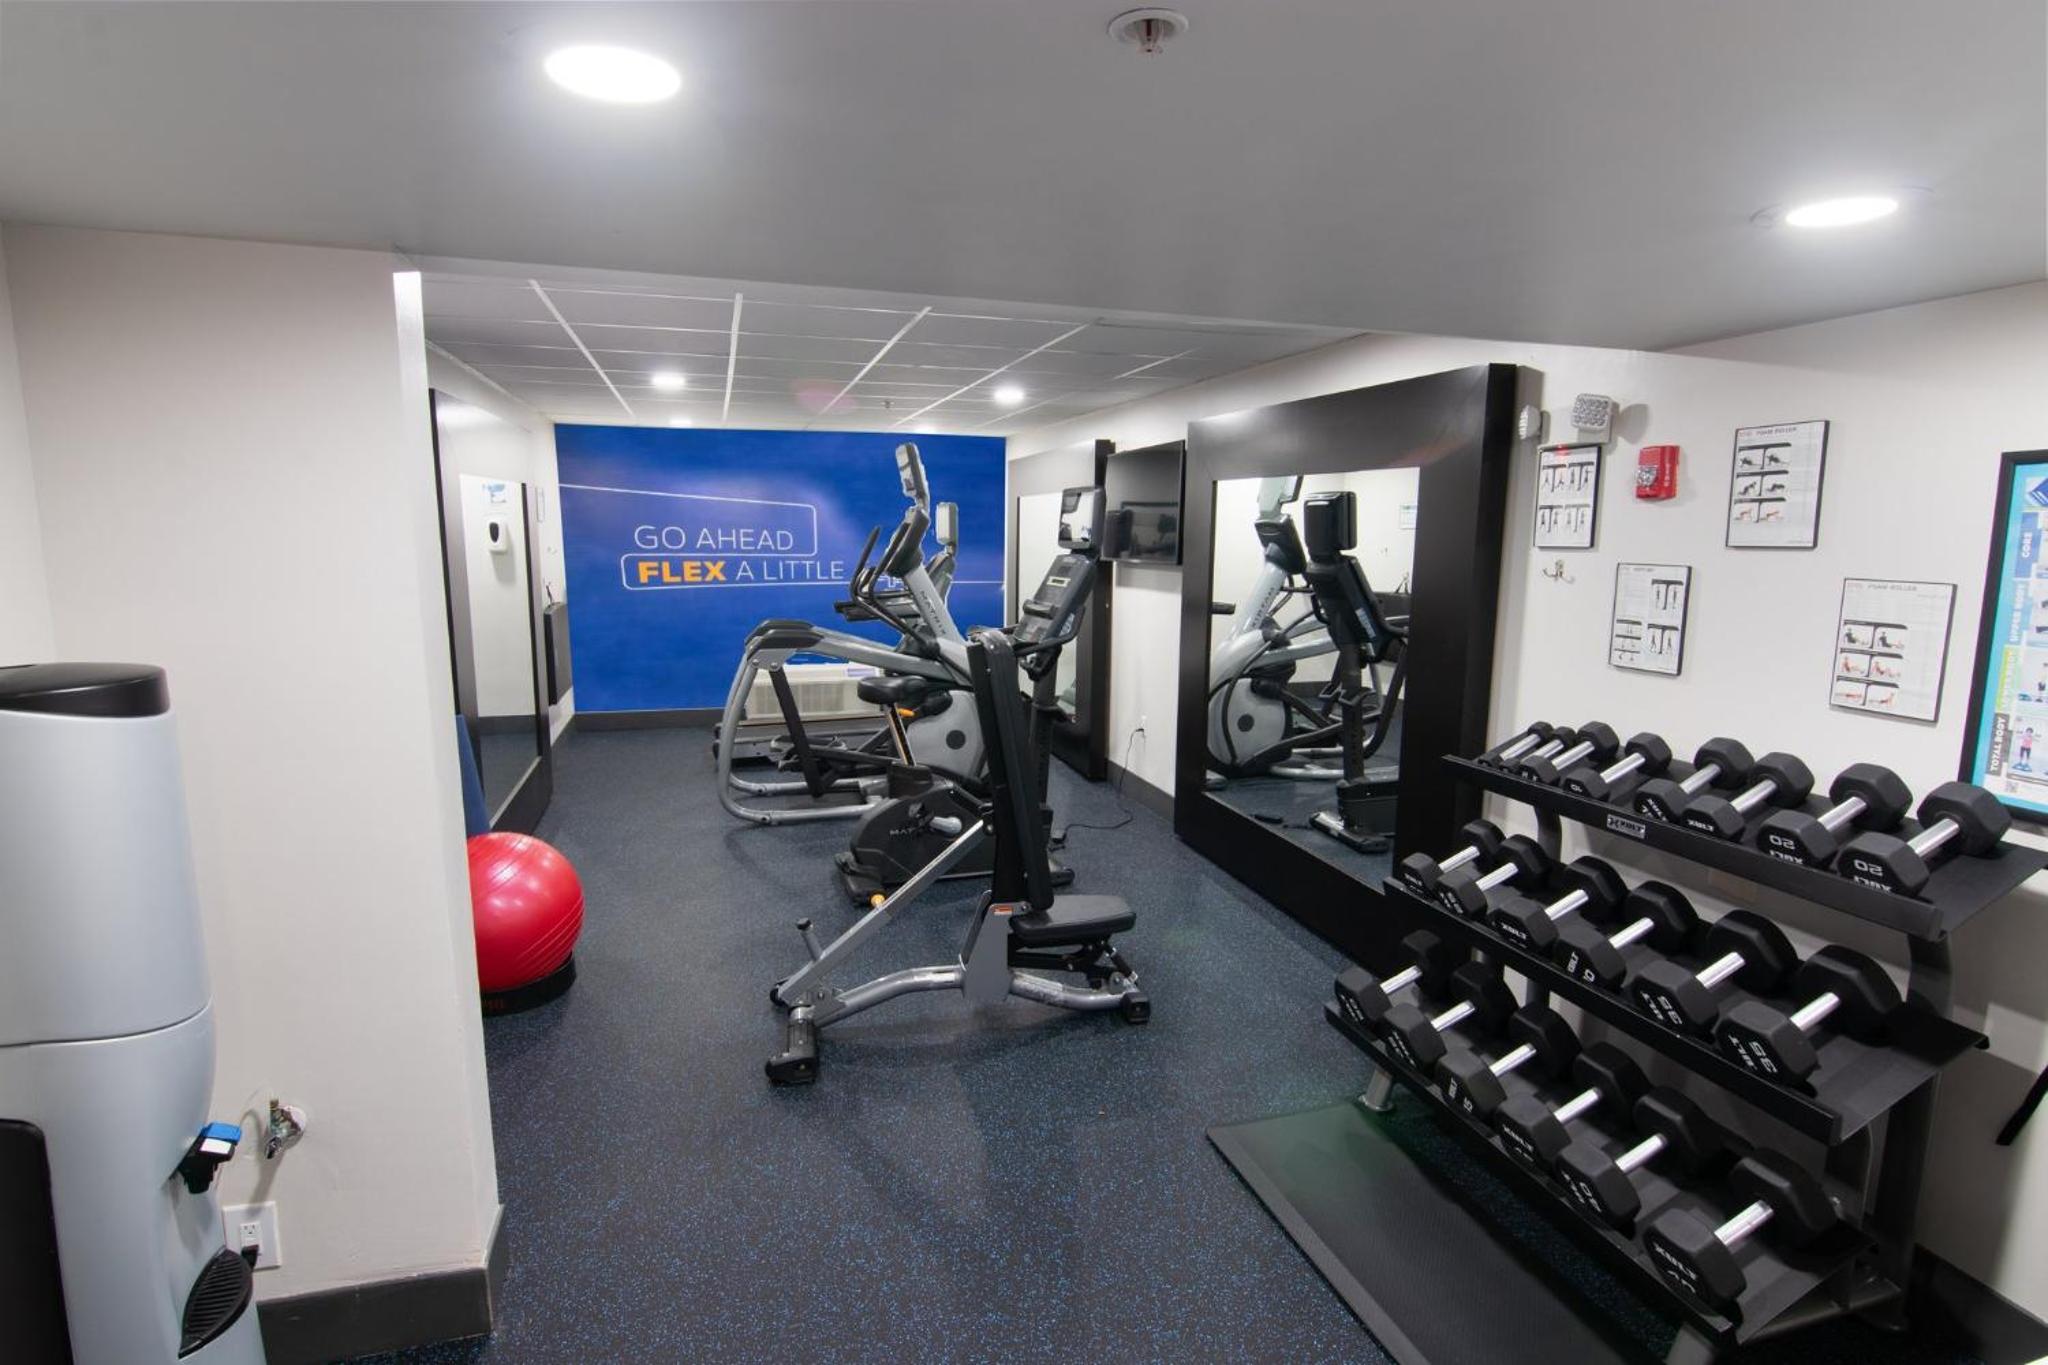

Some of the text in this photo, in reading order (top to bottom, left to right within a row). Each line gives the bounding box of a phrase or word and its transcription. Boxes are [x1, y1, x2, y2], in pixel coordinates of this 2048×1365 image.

[634, 525, 793, 550] GO AHEAD
[2021, 531, 2033, 558] CORE
[638, 560, 845, 584] FLEX A LITTLE
[1990, 716, 2007, 772] TOTAL BODY
[1769, 834, 1796, 850] 20
[1854, 859, 1883, 877] 20
[1640, 990, 1664, 1021] ULT
[1657, 995, 1683, 1025] 35
[1749, 1041, 1778, 1073] 35
